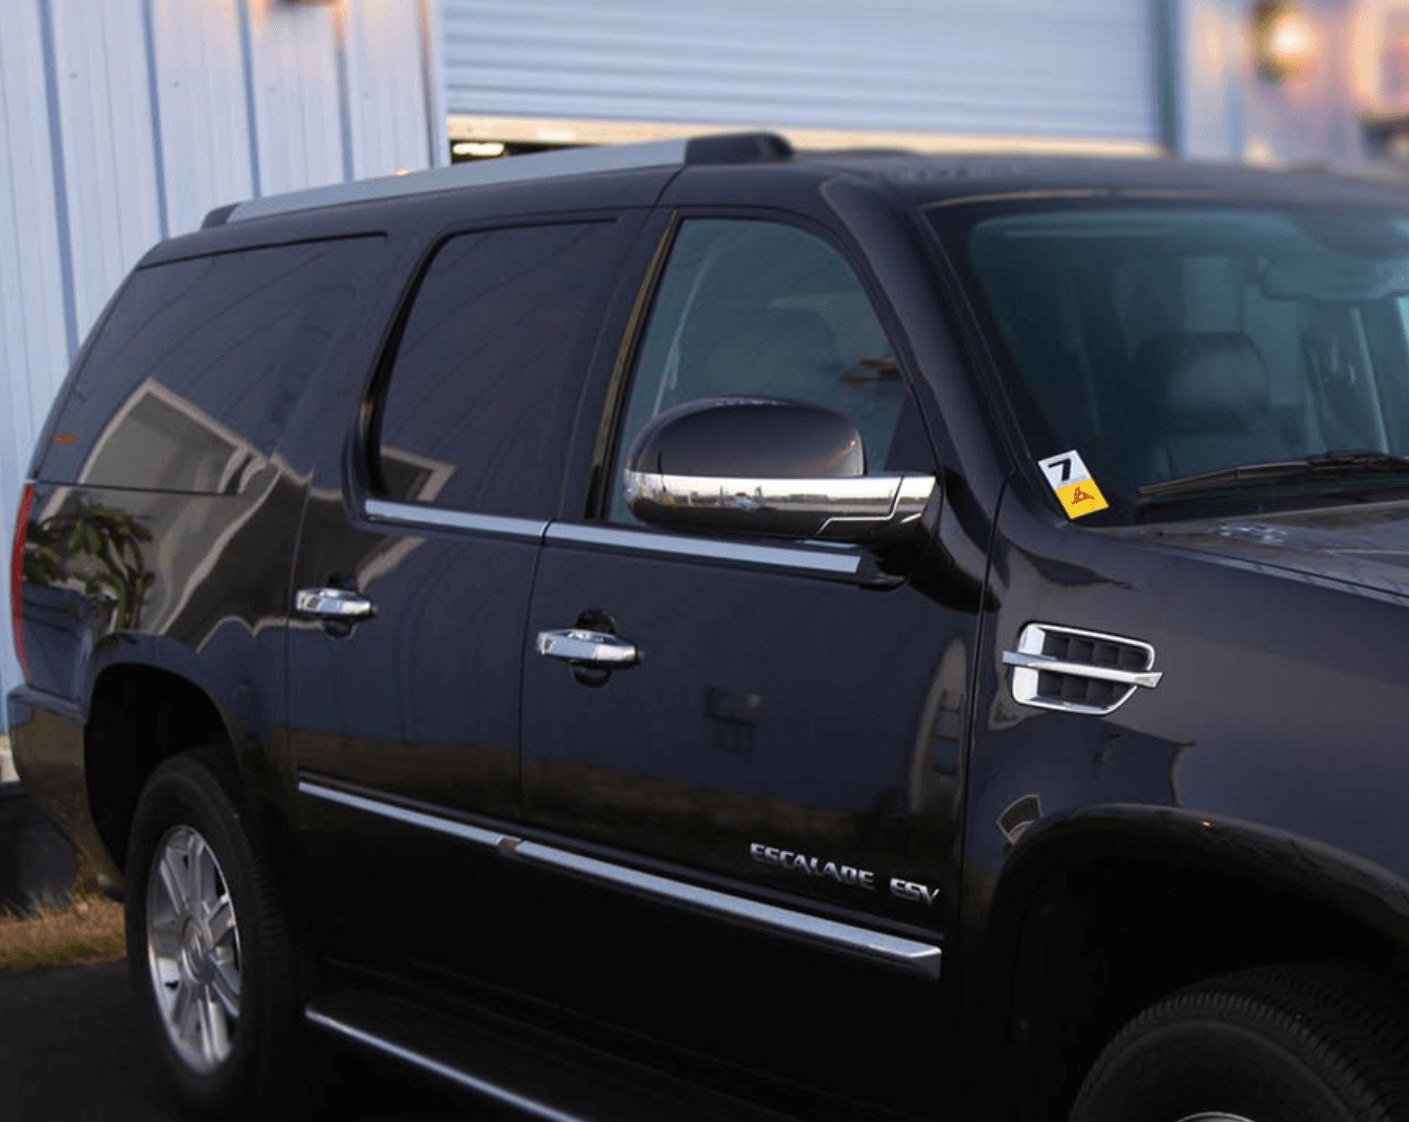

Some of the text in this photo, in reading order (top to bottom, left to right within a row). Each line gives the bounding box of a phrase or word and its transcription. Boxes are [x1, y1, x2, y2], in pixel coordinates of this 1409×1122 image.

[1048, 458, 1071, 481] 7
[750, 843, 940, 905] ESCALADE ESV
